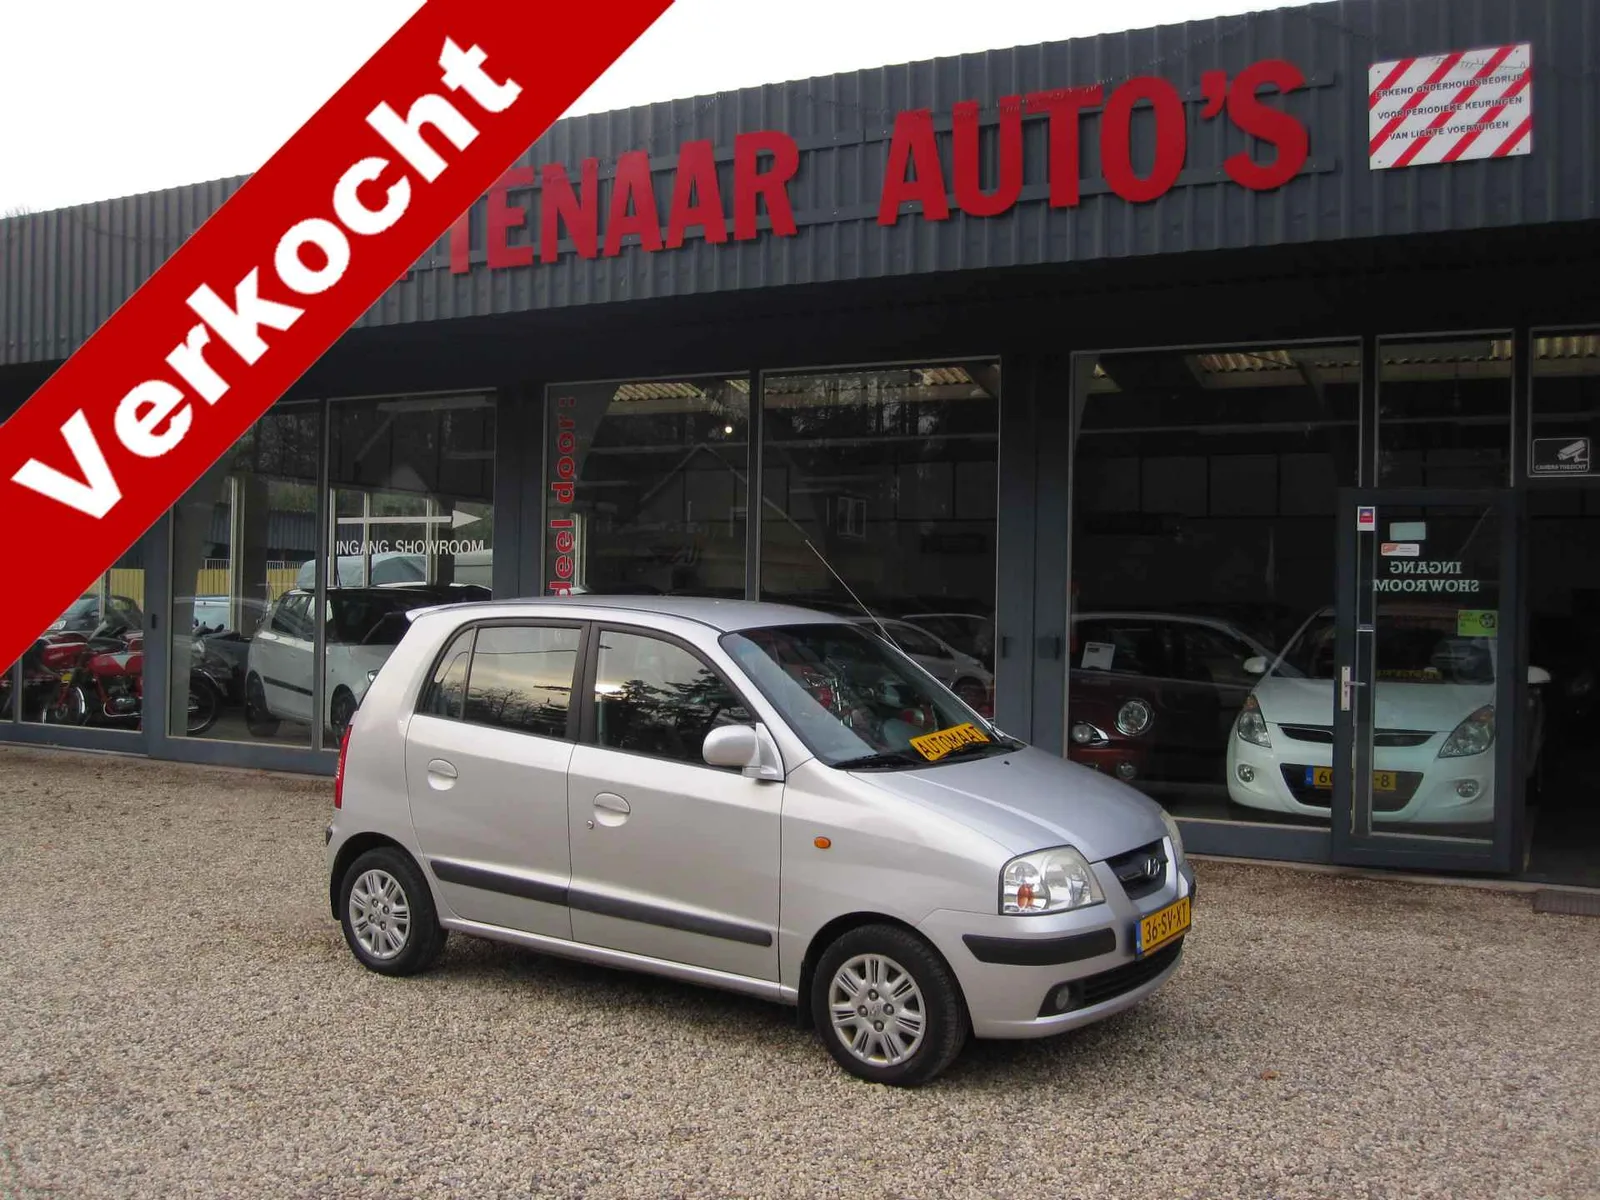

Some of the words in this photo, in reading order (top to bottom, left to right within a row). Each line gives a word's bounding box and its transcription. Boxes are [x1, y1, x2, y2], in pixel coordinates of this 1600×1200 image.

[1376, 87, 1414, 98] ERKEND
[1416, 73, 1523, 93] ONDERHOUDSBEDRIJF
[1377, 110, 1403, 119] VOOR
[1406, 103, 1463, 117] PERIODIEKE
[1465, 96, 1522, 110] KEURINGEN
[877, 58, 1308, 226] AUTO'S
[1390, 131, 1408, 141] VAN
[1411, 127, 1445, 138] LICHTE
[1447, 121, 1509, 134] VOERTUIGEN
[336, 540, 389, 555] INGANG
[396, 539, 484, 555] SHOWROOM
[1145, 902, 1187, 944] 36-SV-XT
